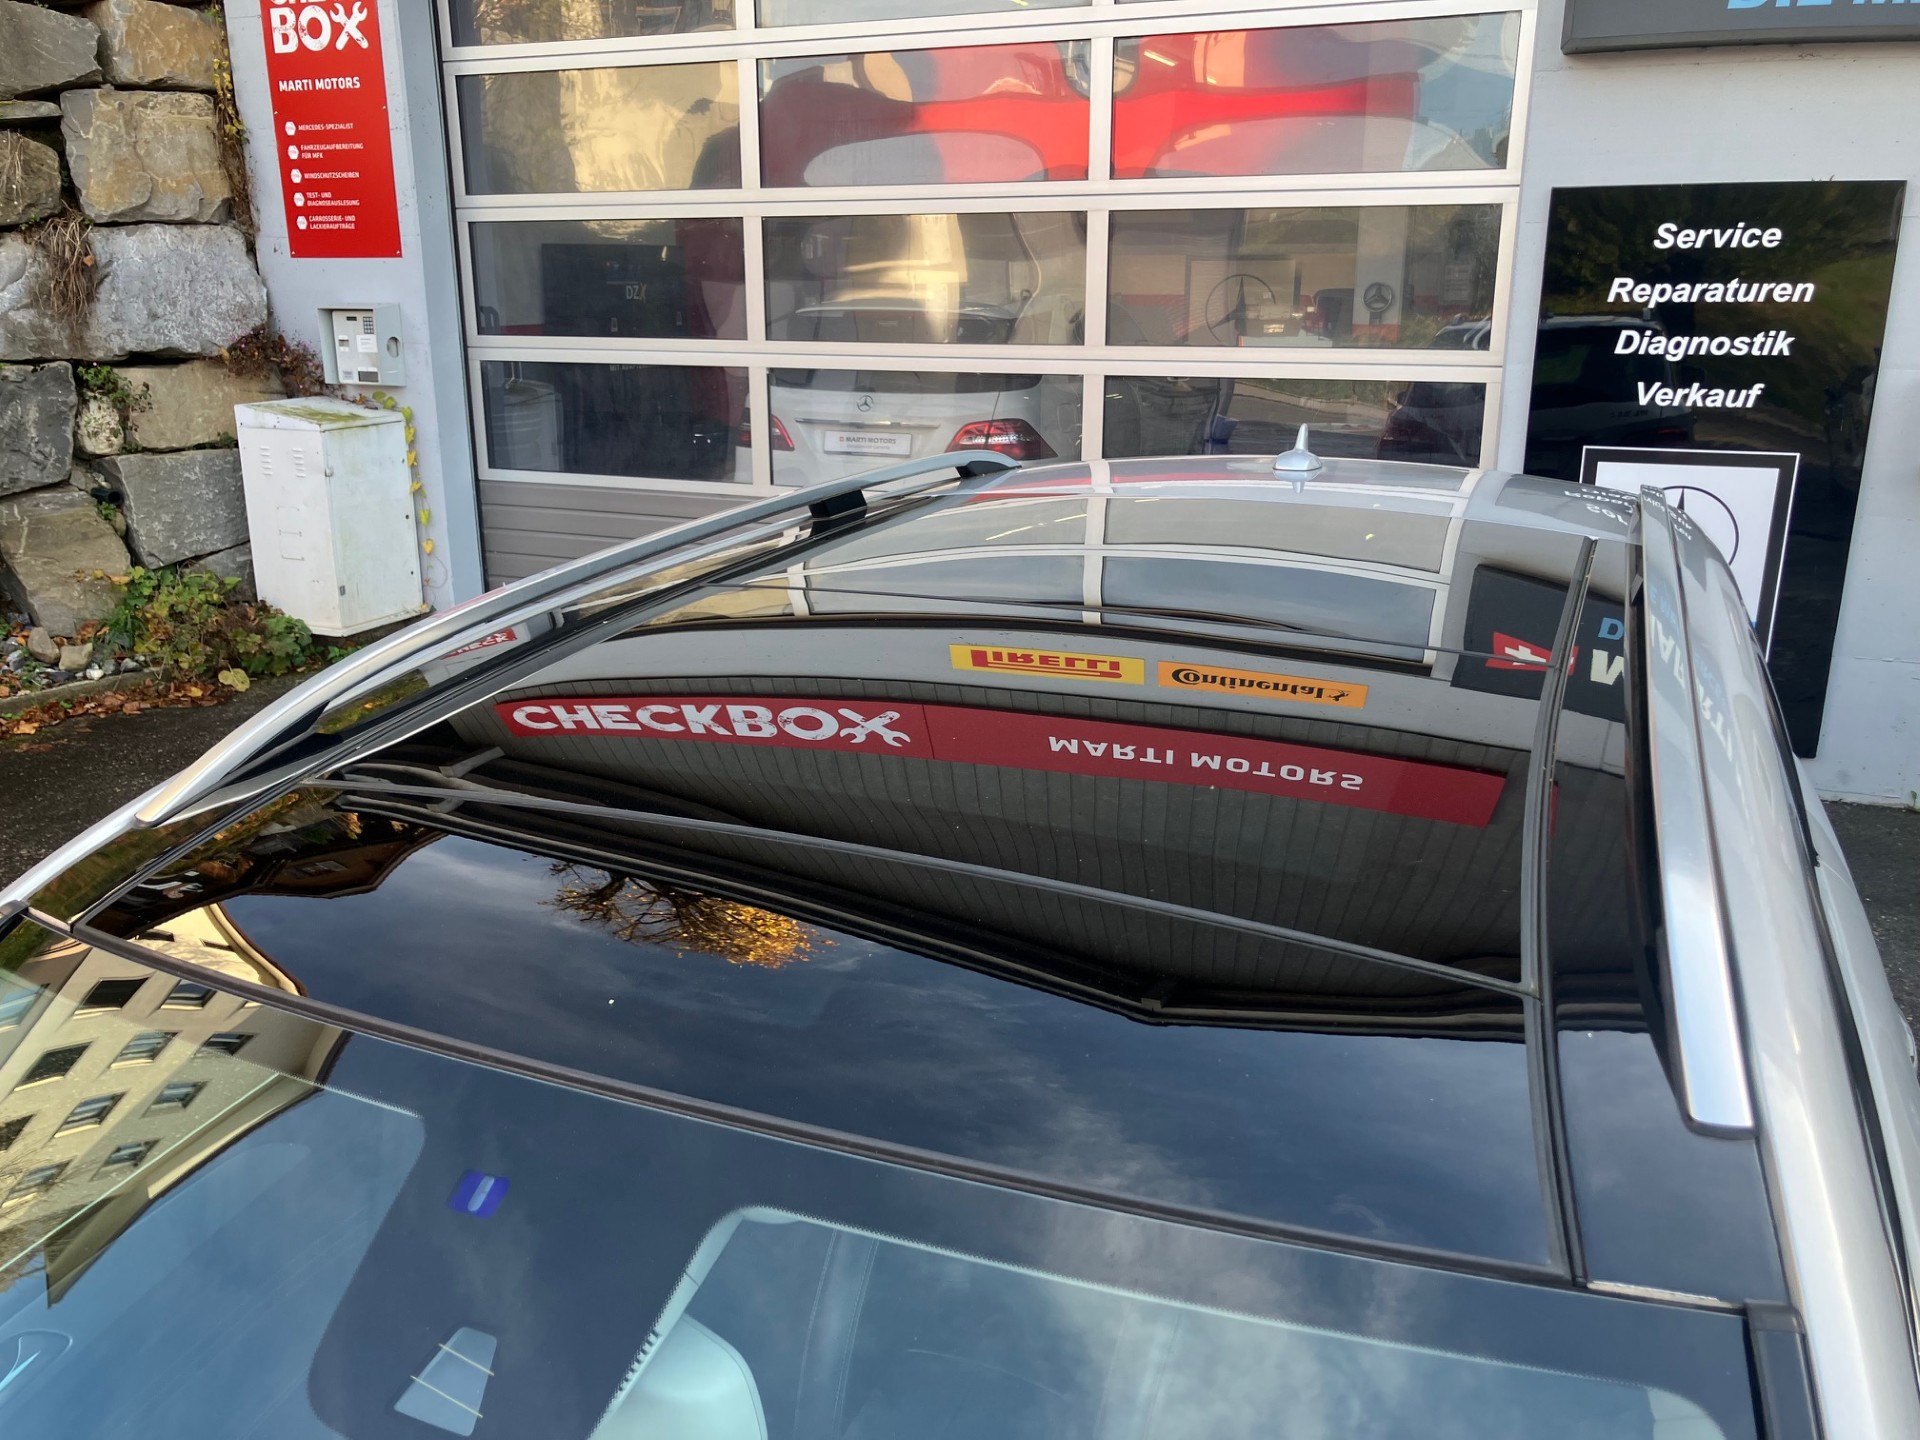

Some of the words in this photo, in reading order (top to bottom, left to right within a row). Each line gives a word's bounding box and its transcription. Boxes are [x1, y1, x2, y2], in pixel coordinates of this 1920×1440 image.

[270, 1, 369, 54] BOX
[279, 79, 313, 92] MARTI
[315, 76, 361, 91] MOTORS
[1653, 222, 1783, 250] Service
[1607, 277, 1815, 310] Reparaturen
[1614, 330, 1796, 362] Diagnostik
[1636, 381, 1765, 409] Verkauf
[845, 436, 867, 444] MARTI
[867, 437, 897, 445] MOTORS
